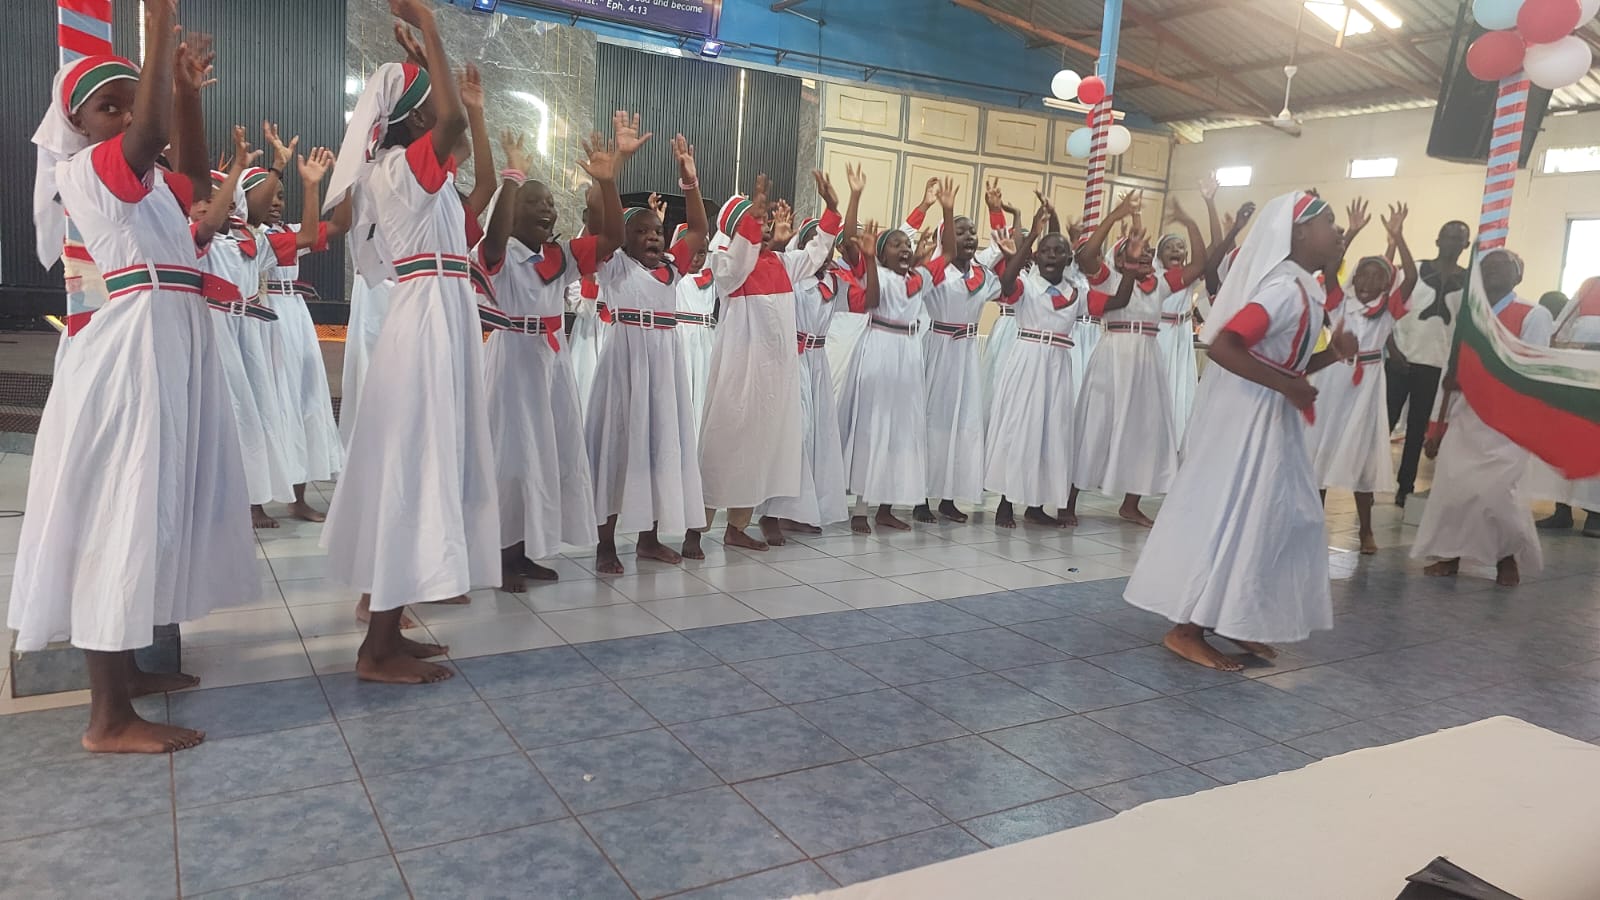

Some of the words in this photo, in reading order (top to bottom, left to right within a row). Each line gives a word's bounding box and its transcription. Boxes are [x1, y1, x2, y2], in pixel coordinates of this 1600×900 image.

[606, 0, 625, 11] Eph.
[628, 5, 648, 15] 4:13
[671, 1, 703, 13] become
